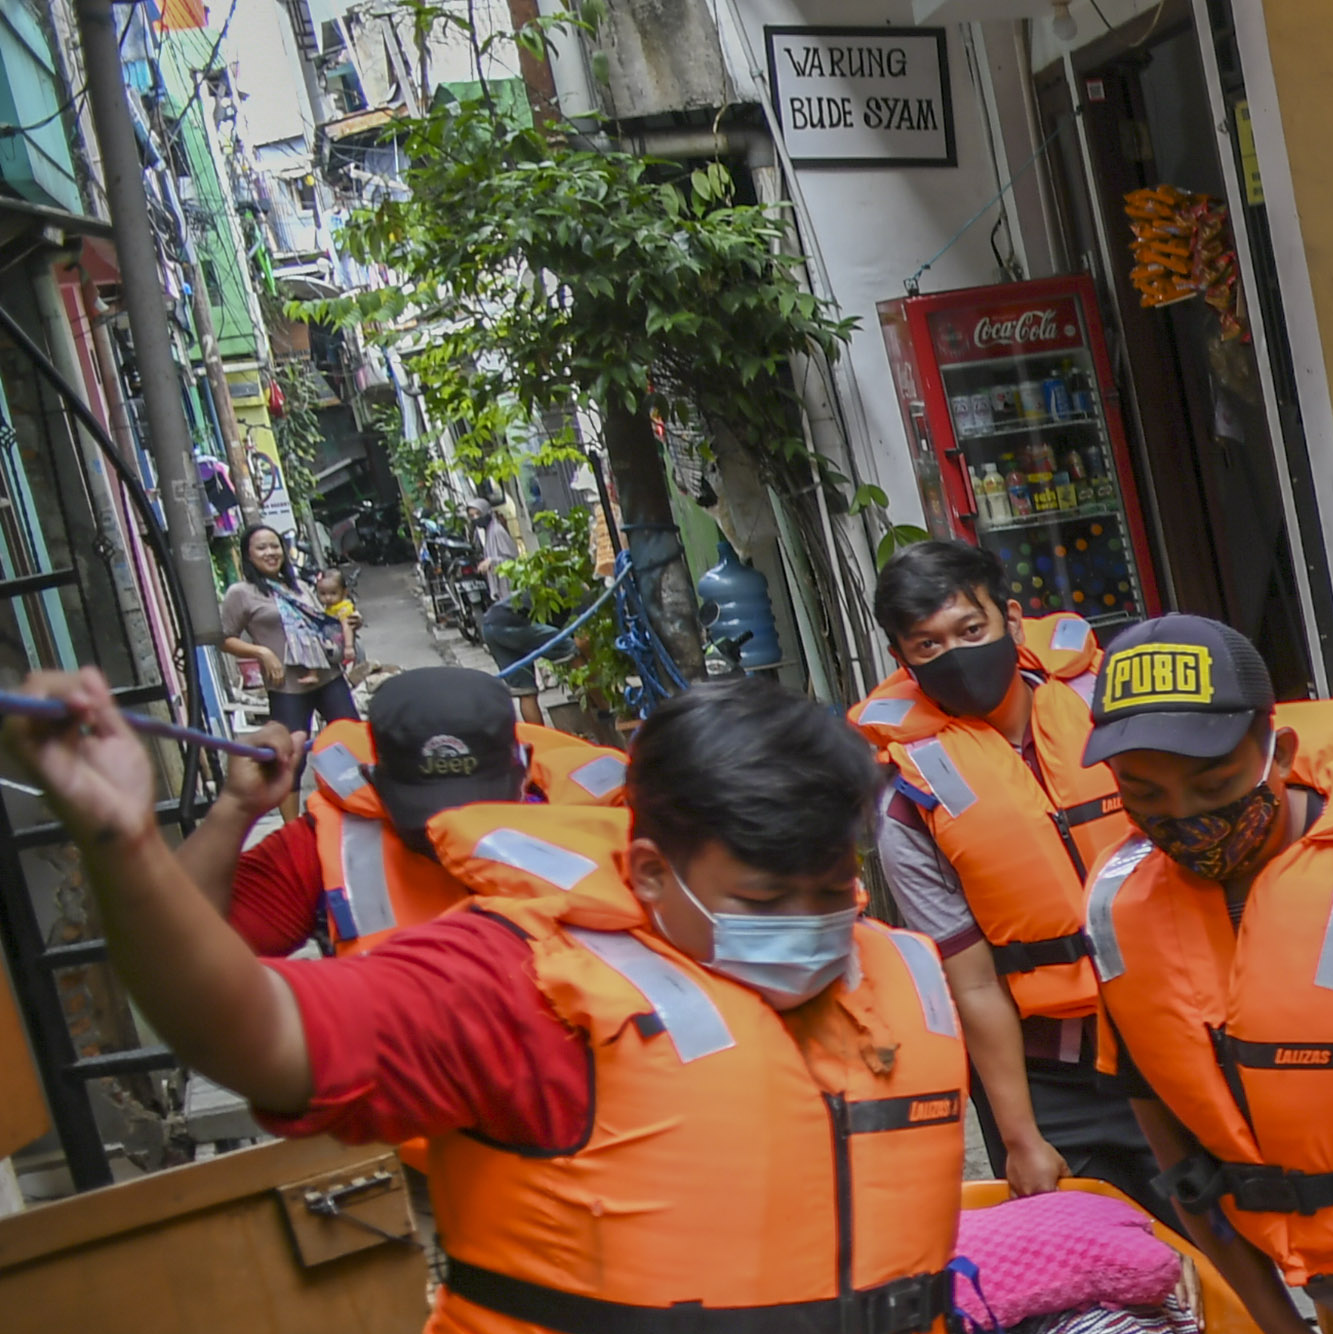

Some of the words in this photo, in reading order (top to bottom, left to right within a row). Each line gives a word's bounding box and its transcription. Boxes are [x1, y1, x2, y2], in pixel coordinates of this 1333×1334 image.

[784, 46, 908, 78] WARUNG
[789, 97, 854, 130] BUDE
[863, 96, 939, 131] SYAM
[1114, 653, 1197, 698] PUBG
[418, 756, 478, 776] Jeep
[1274, 1047, 1331, 1065] LALIZAS
